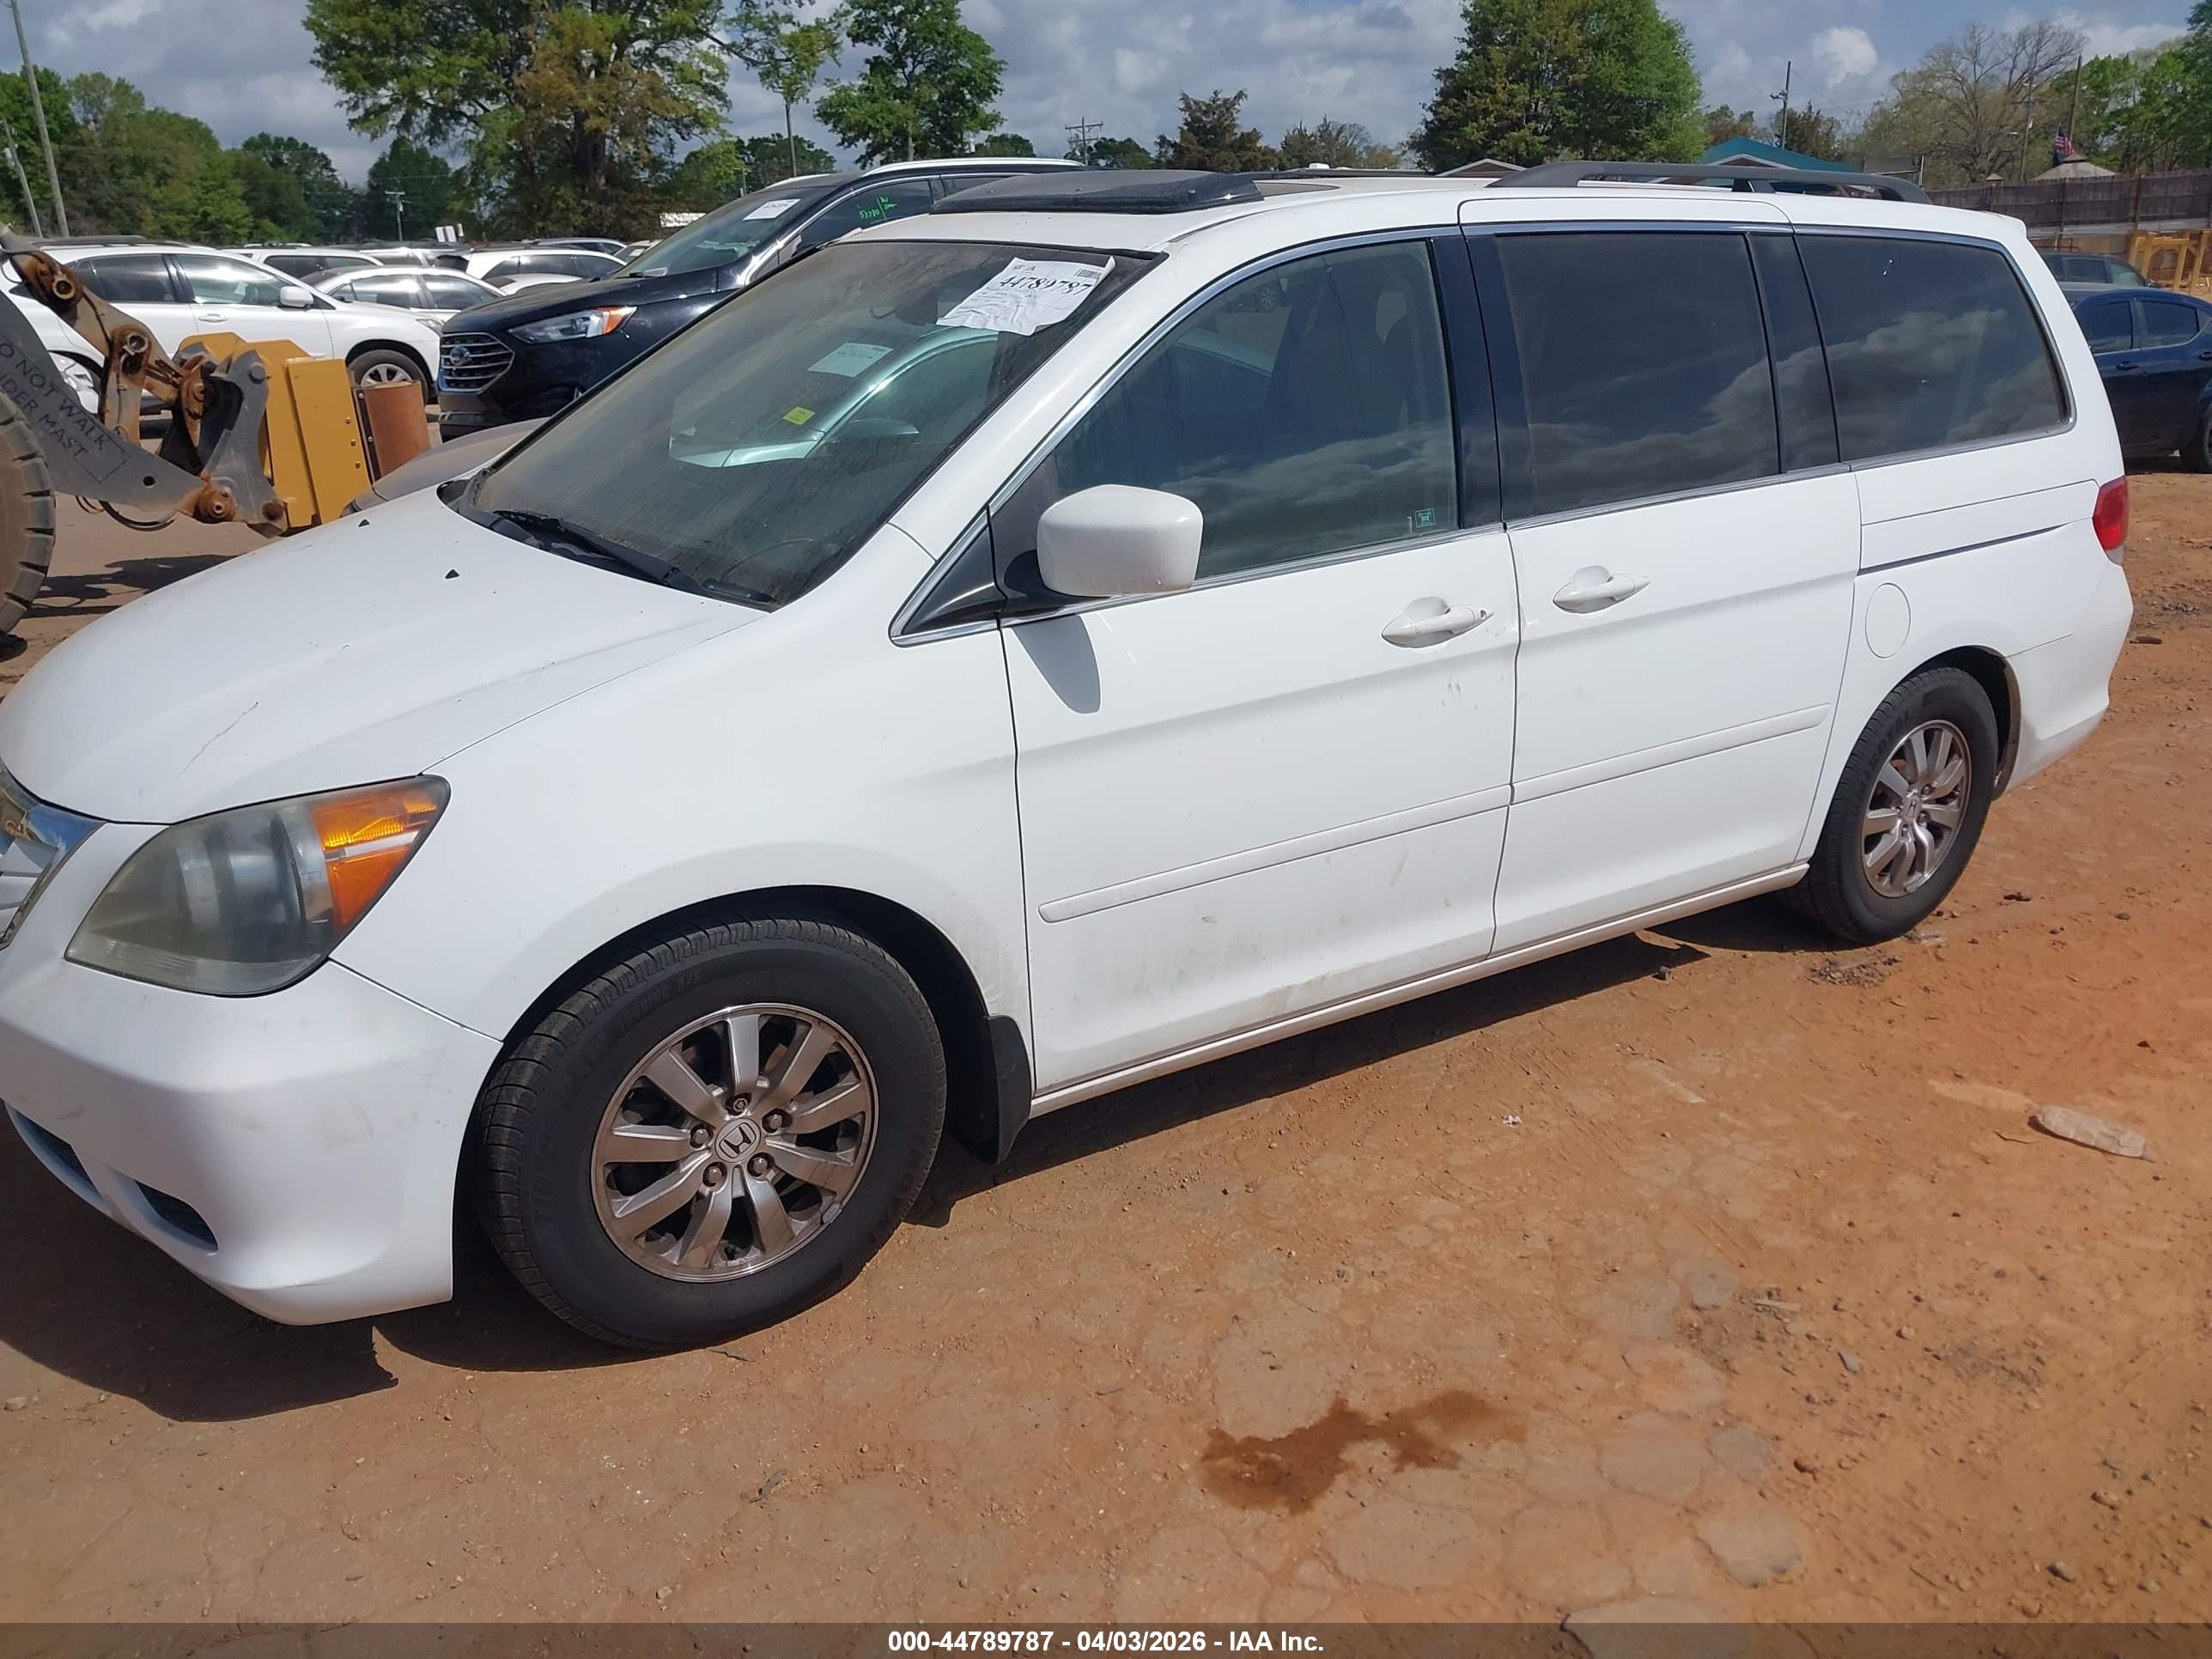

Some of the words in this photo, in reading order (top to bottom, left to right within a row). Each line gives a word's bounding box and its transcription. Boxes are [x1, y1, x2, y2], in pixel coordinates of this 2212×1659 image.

[999, 275, 1093, 295] 44789787
[0, 343, 15, 358] O
[15, 359, 59, 398] NOT
[59, 398, 106, 450] WALK
[39, 413, 88, 458] MAST
